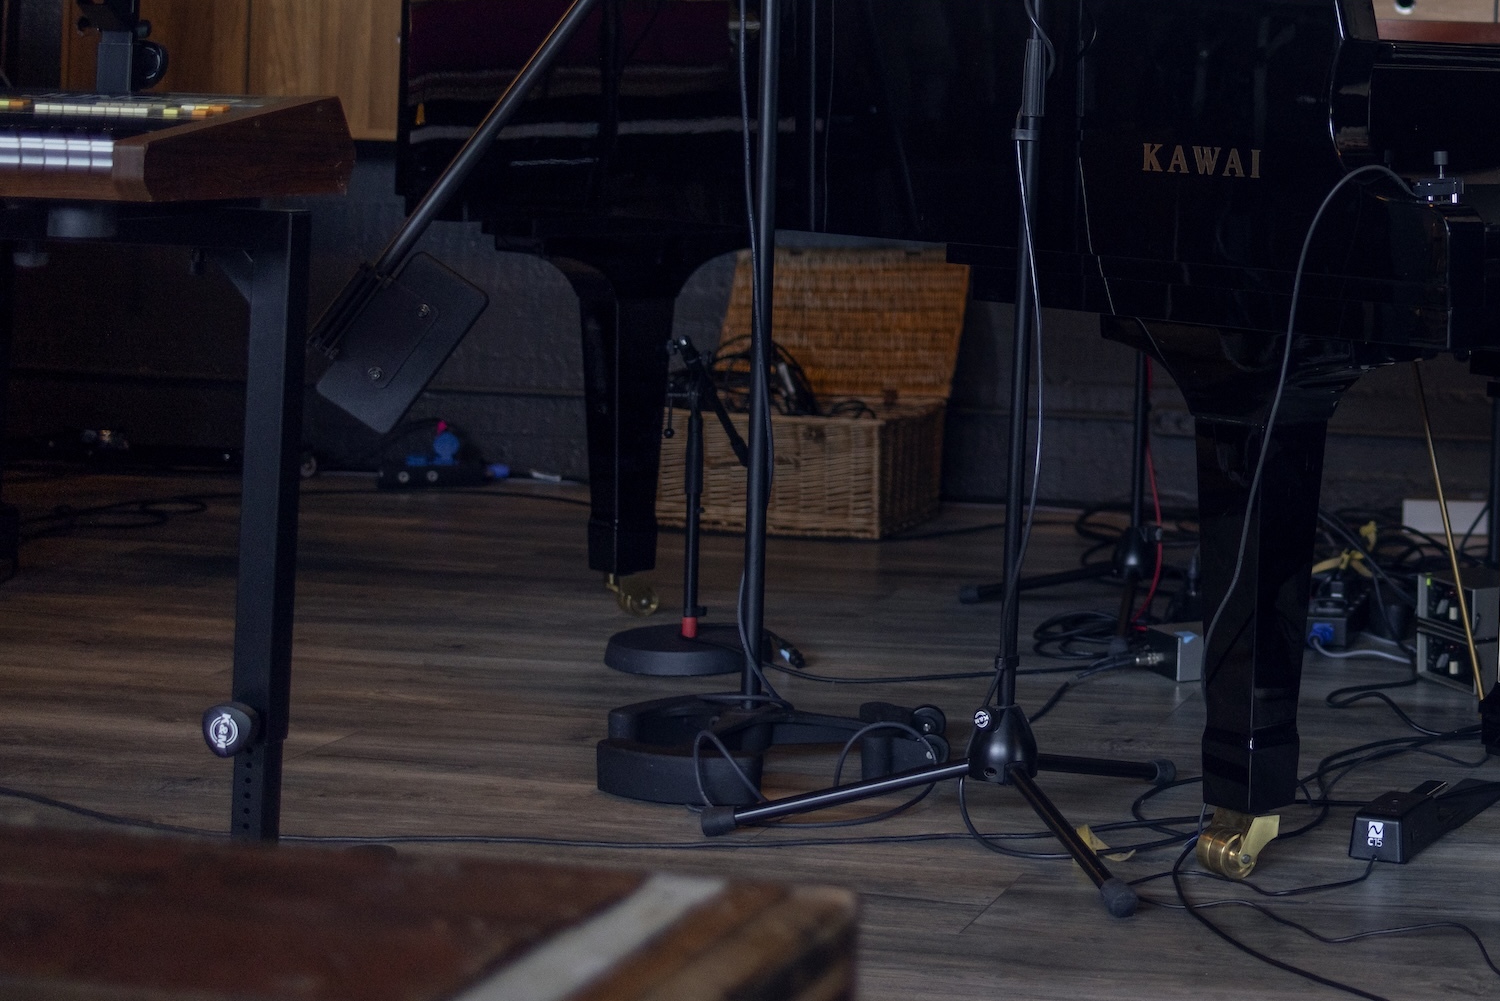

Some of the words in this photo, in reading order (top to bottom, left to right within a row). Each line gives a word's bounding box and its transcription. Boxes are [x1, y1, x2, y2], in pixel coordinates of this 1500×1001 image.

[1142, 143, 1261, 178] KAWAI
[217, 713, 231, 748] K&M
[1367, 838, 1383, 847] C15
